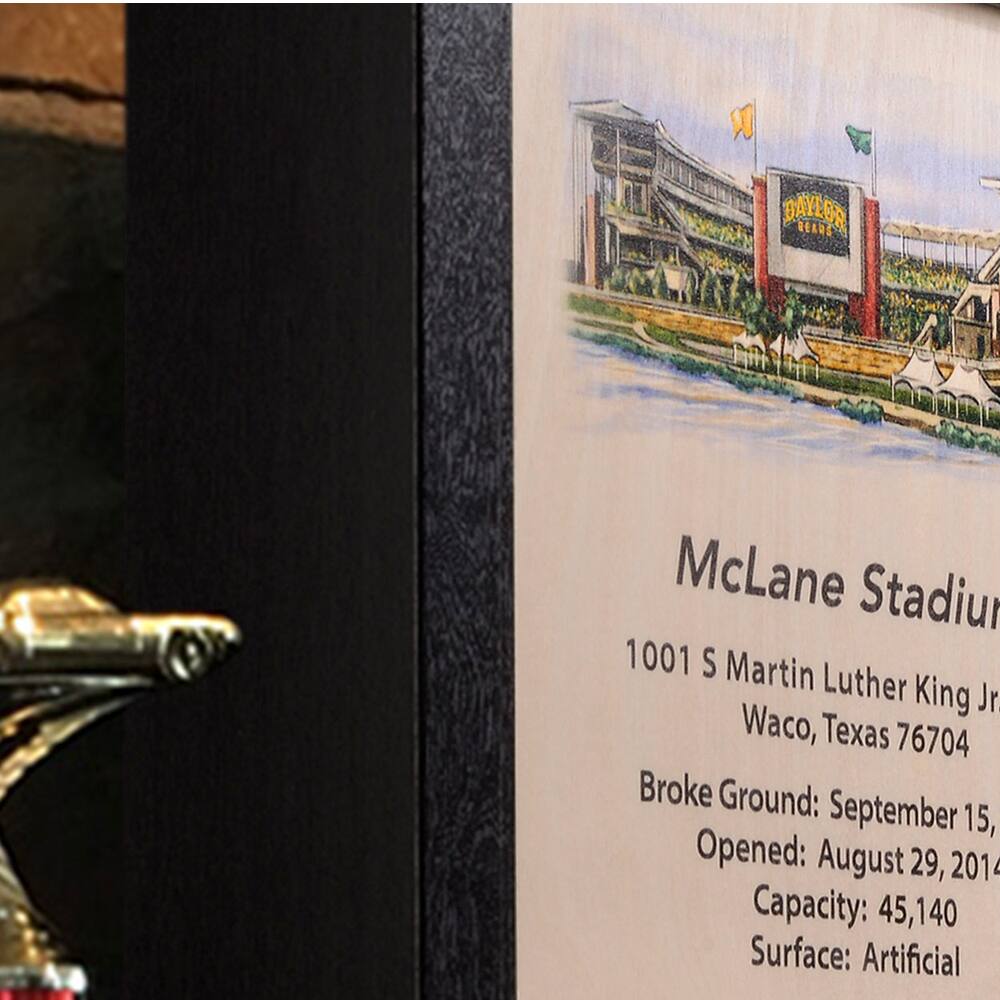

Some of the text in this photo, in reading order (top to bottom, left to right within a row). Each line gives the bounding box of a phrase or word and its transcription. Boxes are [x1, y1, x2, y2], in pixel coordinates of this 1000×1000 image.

[784, 193, 847, 239] BAYLOR
[676, 534, 845, 608] McLane
[626, 637, 689, 676] 1001
[702, 646, 717, 679] S
[726, 649, 814, 691] Martin
[824, 661, 908, 702] Luther
[915, 673, 970, 718] King
[741, 702, 970, 759] Waco, Texas 76704
[639, 769, 713, 808] Broke
[718, 777, 819, 818] Ground:
[830, 788, 958, 831] September
[964, 802, 996, 839] 15,
[696, 827, 806, 870] Opened:
[817, 837, 905, 880] August
[910, 846, 945, 883] 29,
[753, 883, 958, 930] Capacity: 45,140
[751, 934, 960, 977] Surface: Artificial
